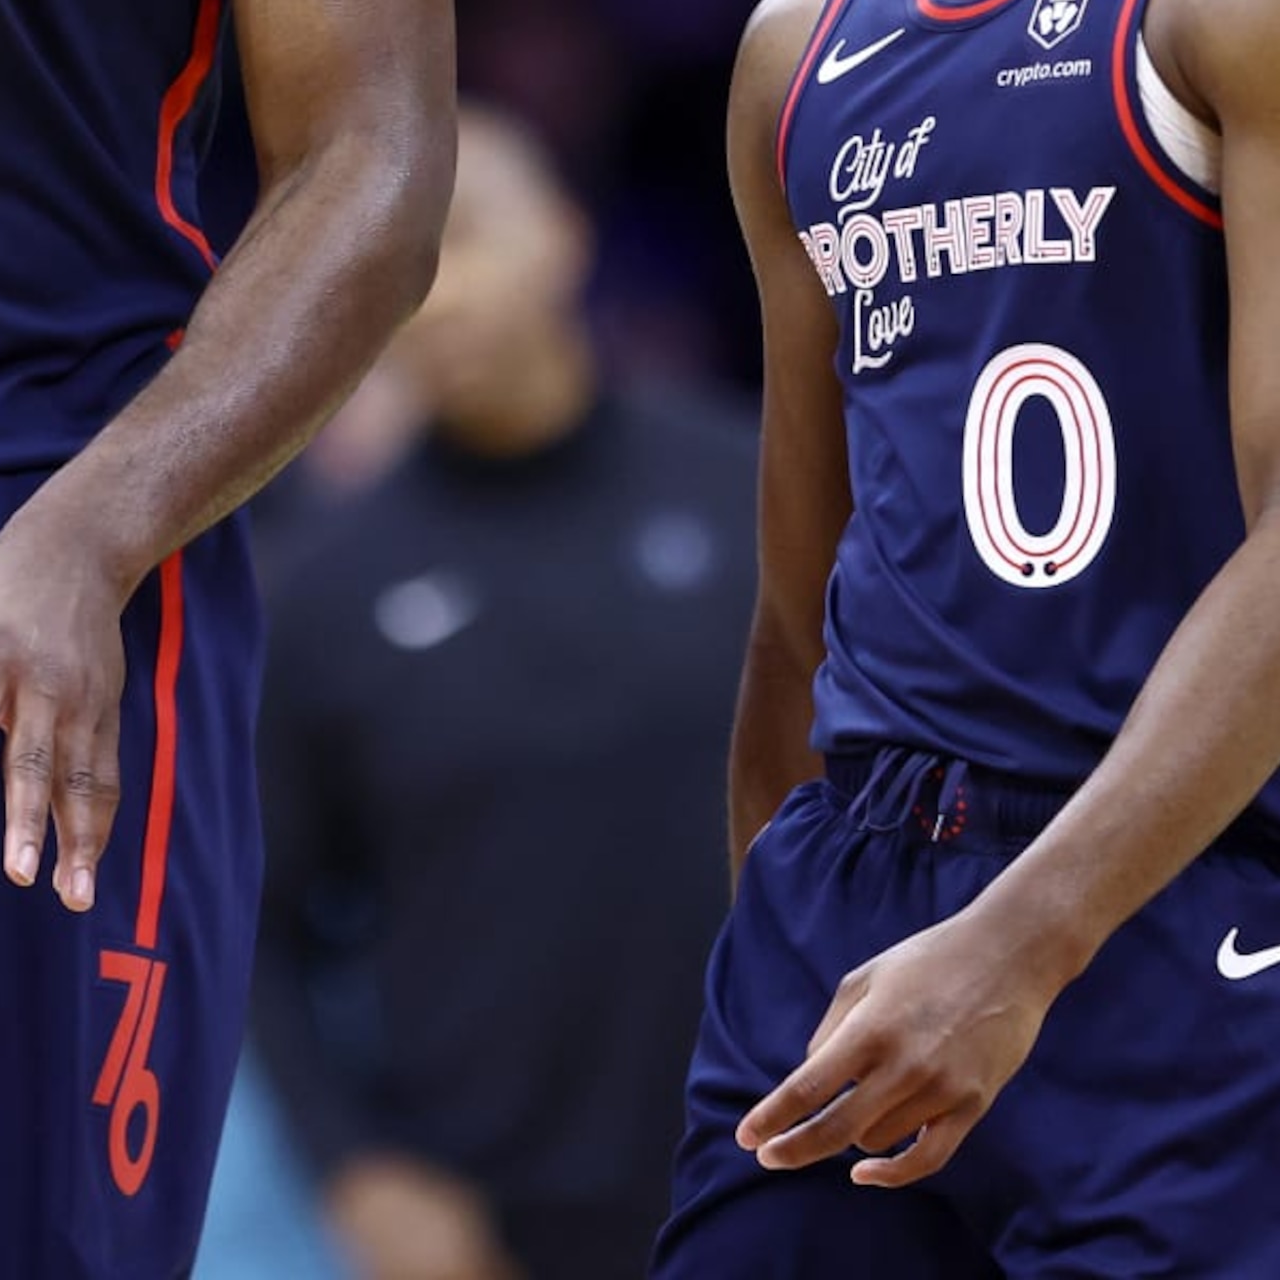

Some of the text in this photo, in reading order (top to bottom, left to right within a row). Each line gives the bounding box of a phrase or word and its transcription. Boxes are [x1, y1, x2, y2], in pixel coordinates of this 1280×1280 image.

[997, 58, 1092, 87] crypto.com
[829, 116, 936, 224] City of
[852, 289, 914, 374] Love
[961, 342, 1117, 589] 0
[92, 949, 168, 1196] 76
